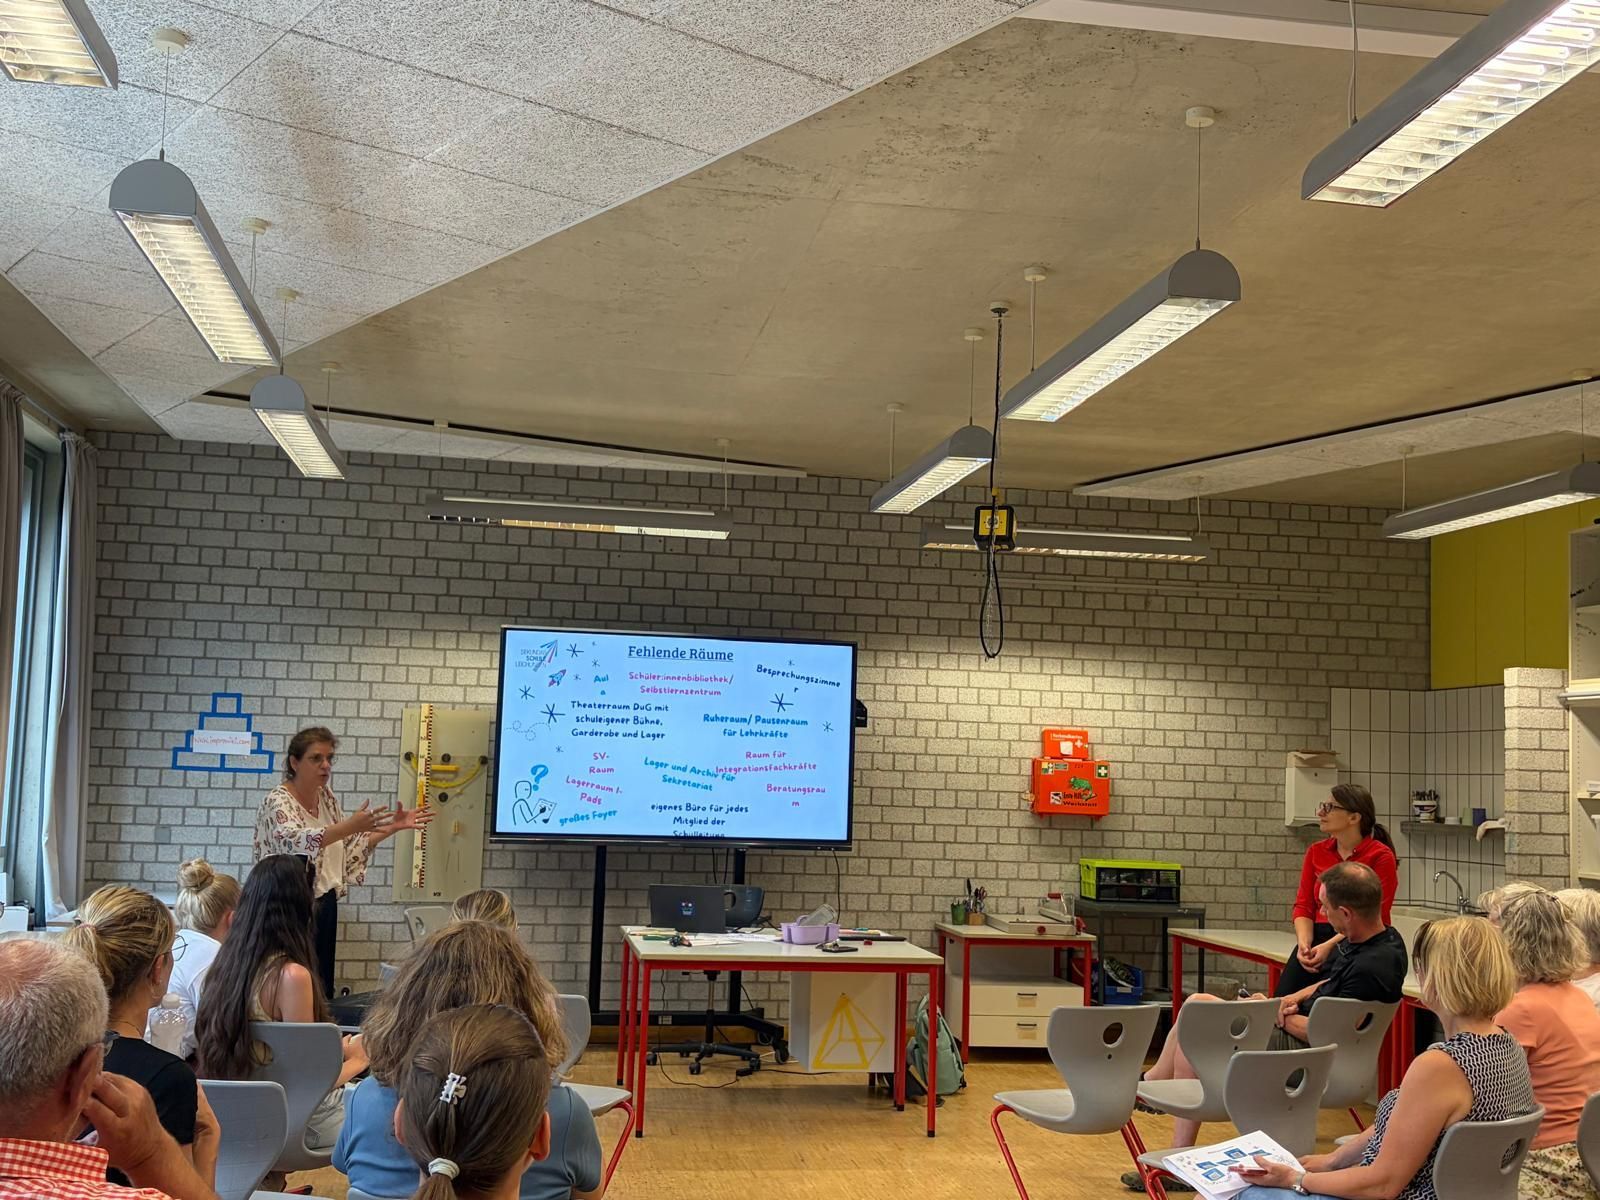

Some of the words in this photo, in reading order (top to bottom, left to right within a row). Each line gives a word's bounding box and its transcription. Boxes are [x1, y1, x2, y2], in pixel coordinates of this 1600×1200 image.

[628, 646, 687, 658] Fehlende
[690, 648, 734, 660] Räume
[628, 672, 734, 685] Schüler:innenbibliothek/
[756, 664, 841, 688] Besprechungszimme
[570, 700, 631, 710] Theaterraum
[632, 702, 652, 712] DuG
[654, 704, 670, 712] mit
[576, 714, 631, 726] schuleigener
[632, 716, 664, 726] Bühne,
[703, 714, 753, 725] Ruheraum/
[754, 715, 809, 726] Pausenraum
[571, 728, 620, 738] Garderobe
[622, 730, 639, 739] und
[640, 730, 666, 741] Lager
[722, 728, 738, 737] für
[740, 728, 789, 738] Lehrkräfte
[592, 752, 610, 760] SV-
[745, 752, 770, 760] Raum
[772, 750, 787, 758] für
[588, 766, 614, 774] Raum
[644, 757, 670, 770] Lager
[672, 763, 688, 772] und
[689, 766, 718, 779] Archiv
[722, 772, 736, 782] für
[716, 762, 817, 775] Integrationsfachkräfte
[566, 776, 614, 793] Lagerraum
[662, 774, 713, 791] Sekretariat
[766, 784, 826, 795] Beratungsrau
[580, 792, 602, 805] Pads
[650, 804, 682, 812] eigenes
[685, 802, 706, 812] Büro
[710, 803, 724, 812] für
[725, 804, 749, 814] jedes
[559, 813, 590, 826] großes
[592, 810, 618, 820] Foyer
[673, 816, 708, 827] Mitglied
[711, 818, 726, 826] der
